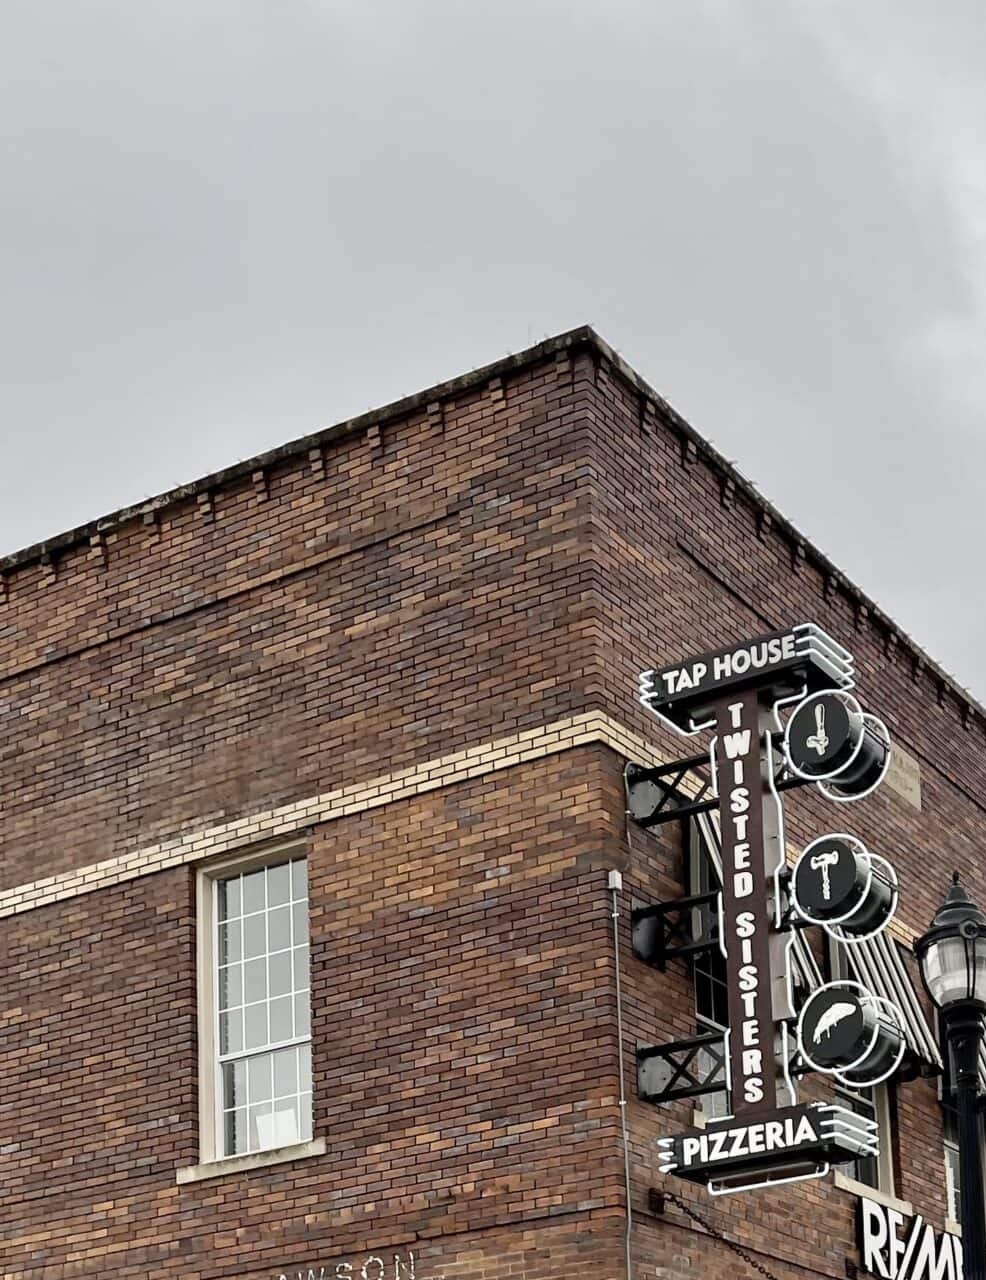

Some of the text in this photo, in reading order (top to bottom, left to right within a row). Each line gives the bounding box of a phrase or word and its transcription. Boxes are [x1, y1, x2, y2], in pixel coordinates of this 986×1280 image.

[662, 634, 797, 694] TAP HOUSE
[723, 702, 755, 899] TWISTED
[735, 911, 764, 1103] SISTERS
[682, 1118, 818, 1166] PIZZERIA
